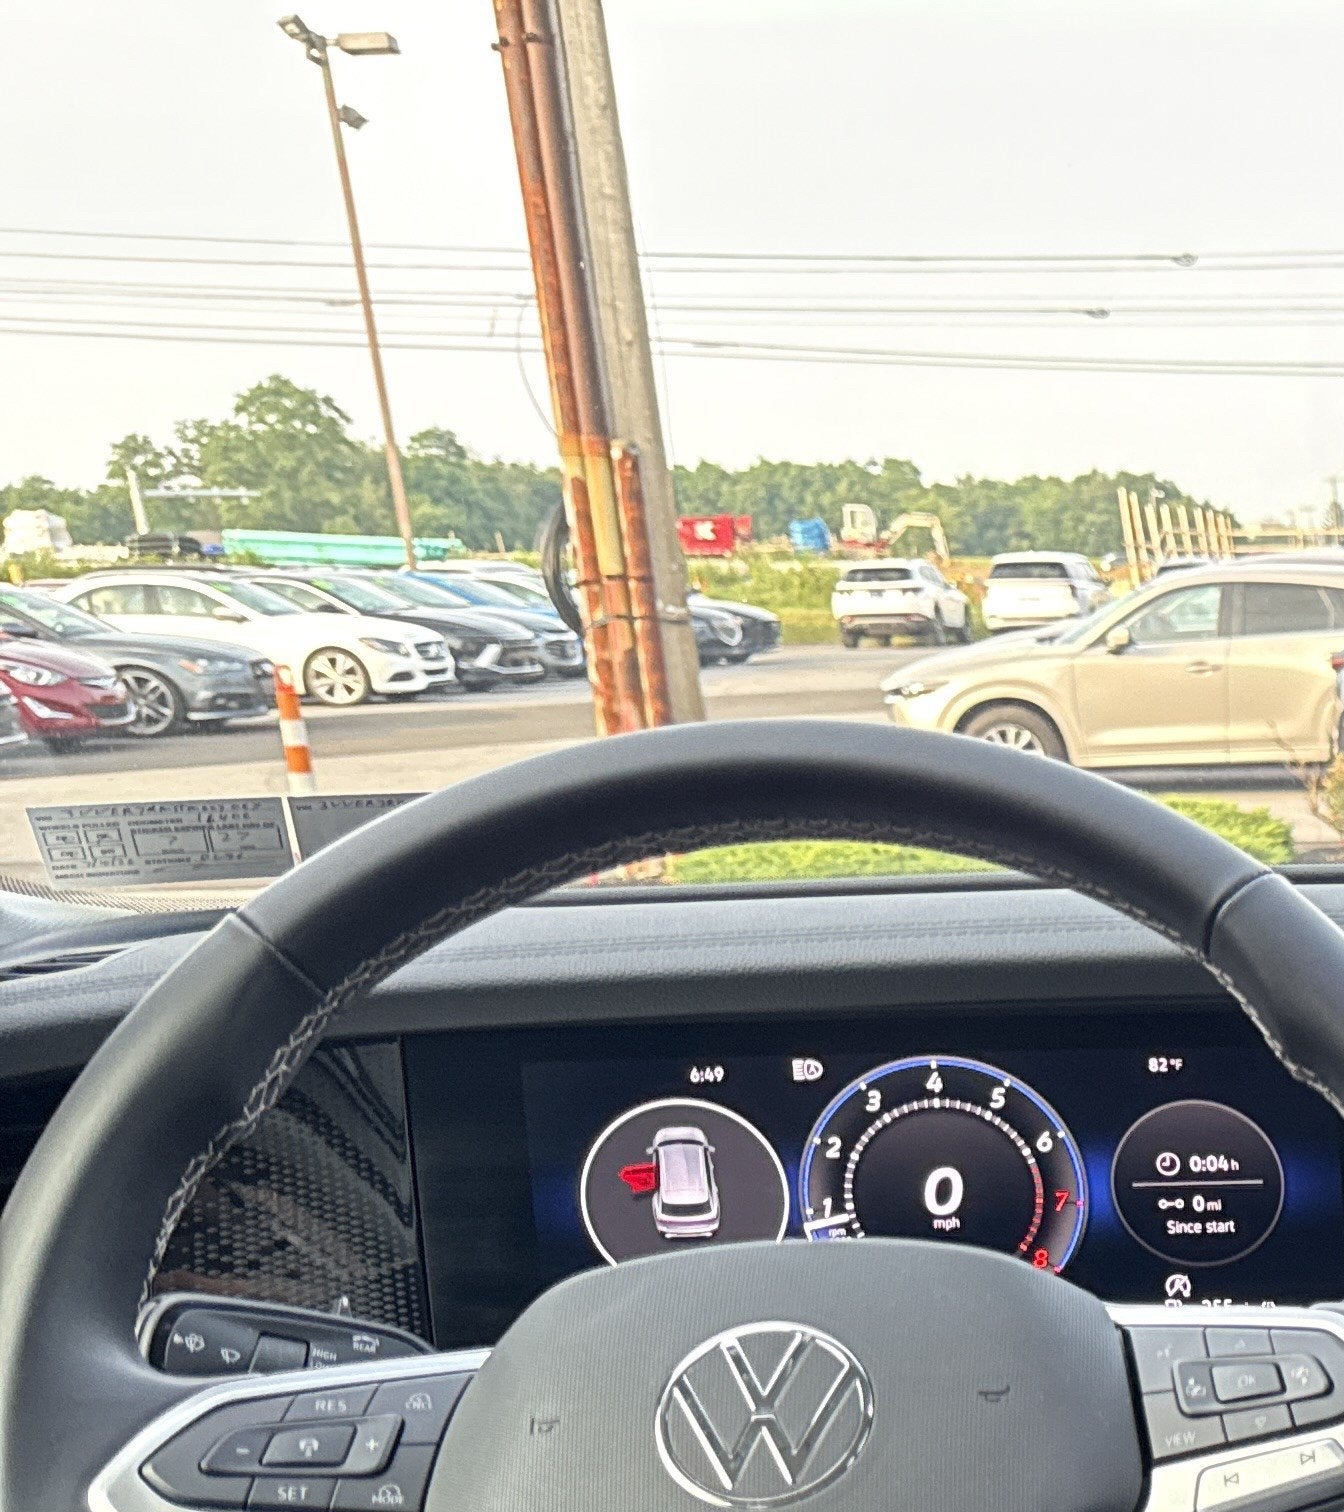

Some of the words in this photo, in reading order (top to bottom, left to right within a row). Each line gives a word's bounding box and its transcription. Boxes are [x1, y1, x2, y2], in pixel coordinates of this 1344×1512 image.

[689, 1065, 725, 1083] 6:49
[926, 1071, 944, 1094] 4
[865, 1090, 882, 1112] 3
[990, 1087, 1006, 1109] 5
[825, 1136, 842, 1159] 2
[1036, 1131, 1053, 1153] 6
[1189, 1155, 1229, 1172] 0:04
[924, 1167, 964, 1216] 0
[1054, 1190, 1070, 1212] 7
[822, 1197, 832, 1218] 1
[1192, 1195, 1204, 1212] 0
[933, 1216, 960, 1232] mph
[1166, 1220, 1202, 1235] Since
[1205, 1219, 1236, 1233] start
[1032, 1249, 1049, 1268] 8
[315, 1400, 347, 1412] RES
[1165, 1432, 1196, 1448] VIEW
[277, 1486, 308, 1501] SET
